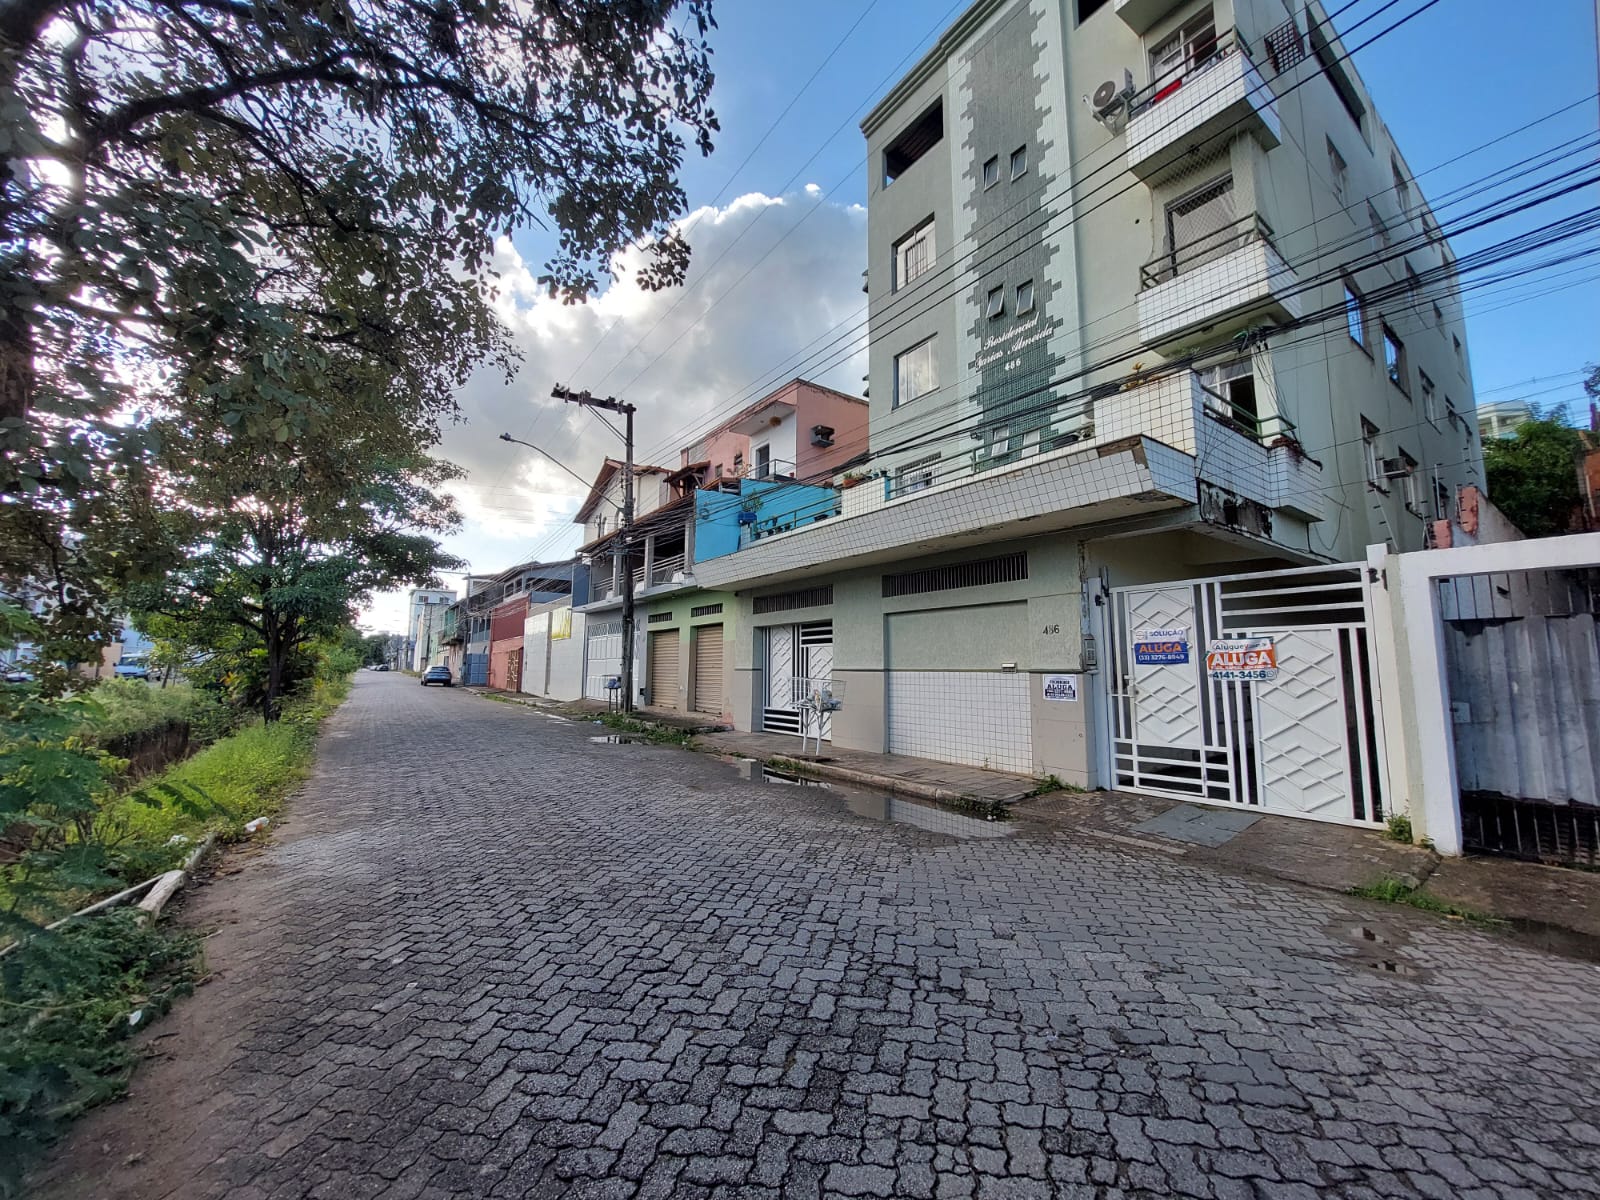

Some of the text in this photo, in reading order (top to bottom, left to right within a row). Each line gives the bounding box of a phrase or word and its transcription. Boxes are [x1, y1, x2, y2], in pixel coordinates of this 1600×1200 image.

[1042, 624, 1060, 635] 486
[1139, 643, 1182, 653] ALUGA
[1211, 651, 1272, 666] ALUGA
[1212, 670, 1267, 679] 4141-3456
